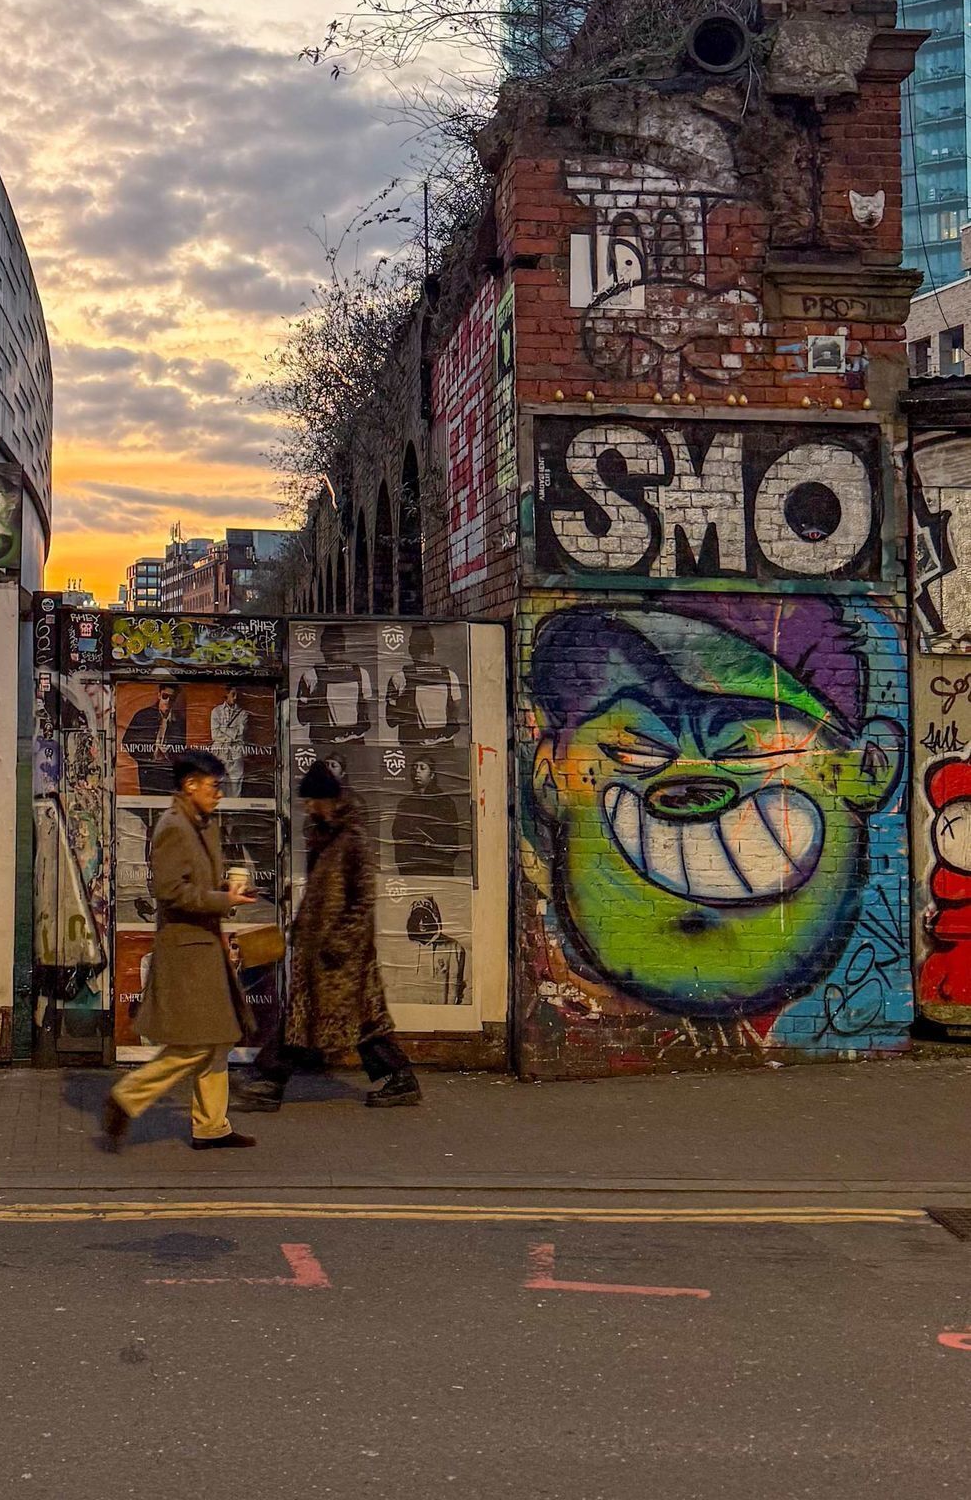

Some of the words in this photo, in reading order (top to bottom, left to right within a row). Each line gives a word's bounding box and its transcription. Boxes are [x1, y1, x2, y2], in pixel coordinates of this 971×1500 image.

[382, 633, 404, 643] TAR
[240, 746, 272, 755] ARMANI
[383, 759, 406, 769] TAR
[245, 995, 273, 1004] RMANI
